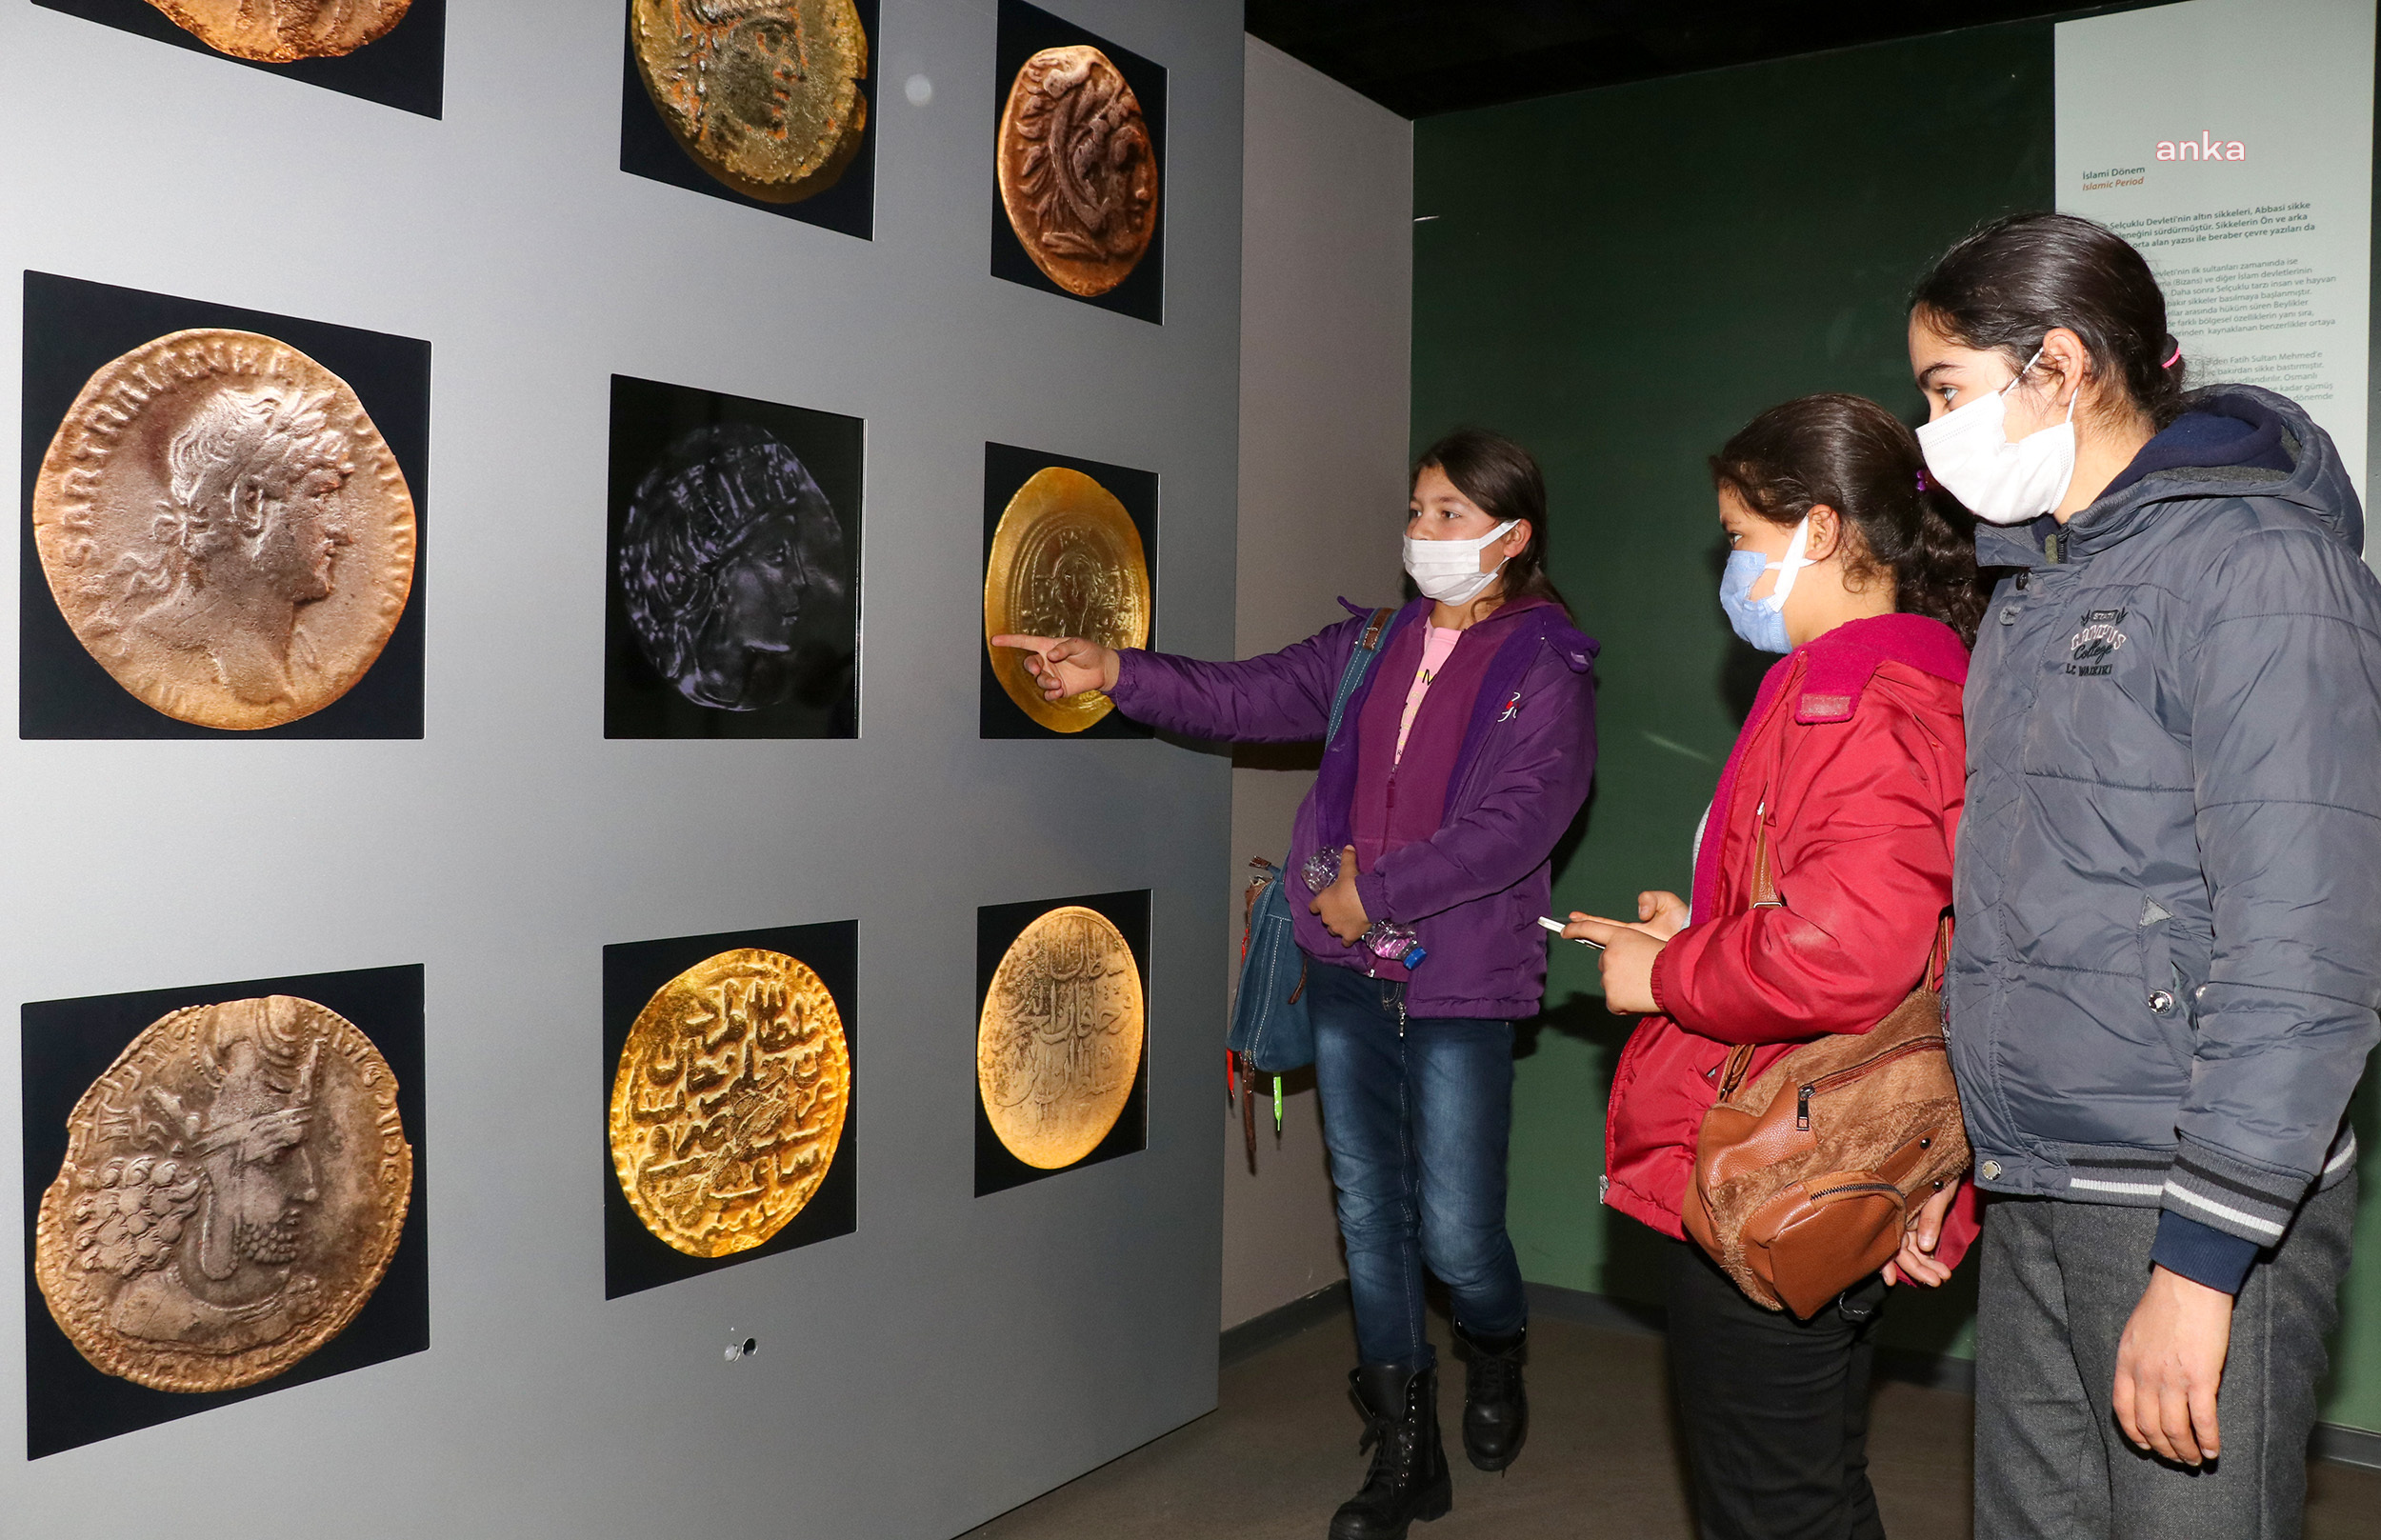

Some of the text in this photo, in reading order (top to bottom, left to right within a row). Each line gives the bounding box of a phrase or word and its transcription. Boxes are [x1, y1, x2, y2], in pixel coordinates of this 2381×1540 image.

[2082, 167, 2146, 180] İslami Dönem
[2082, 176, 2145, 191] Islamic Period
[2110, 219, 2145, 230] Selçuklu
[2147, 215, 2191, 227] Devleti'nin
[2192, 211, 2212, 221] altın
[2254, 204, 2286, 214] Abbasi
[2287, 201, 2311, 210] sikke
[2215, 218, 2258, 230] Sikkelerin
[2288, 213, 2308, 222] arka
[2151, 237, 2170, 247] alan
[2209, 231, 2242, 241] beraber
[2244, 229, 2269, 239] çevre
[2303, 222, 2315, 231] da
[2065, 663, 2113, 677] LC WAIKIKI
